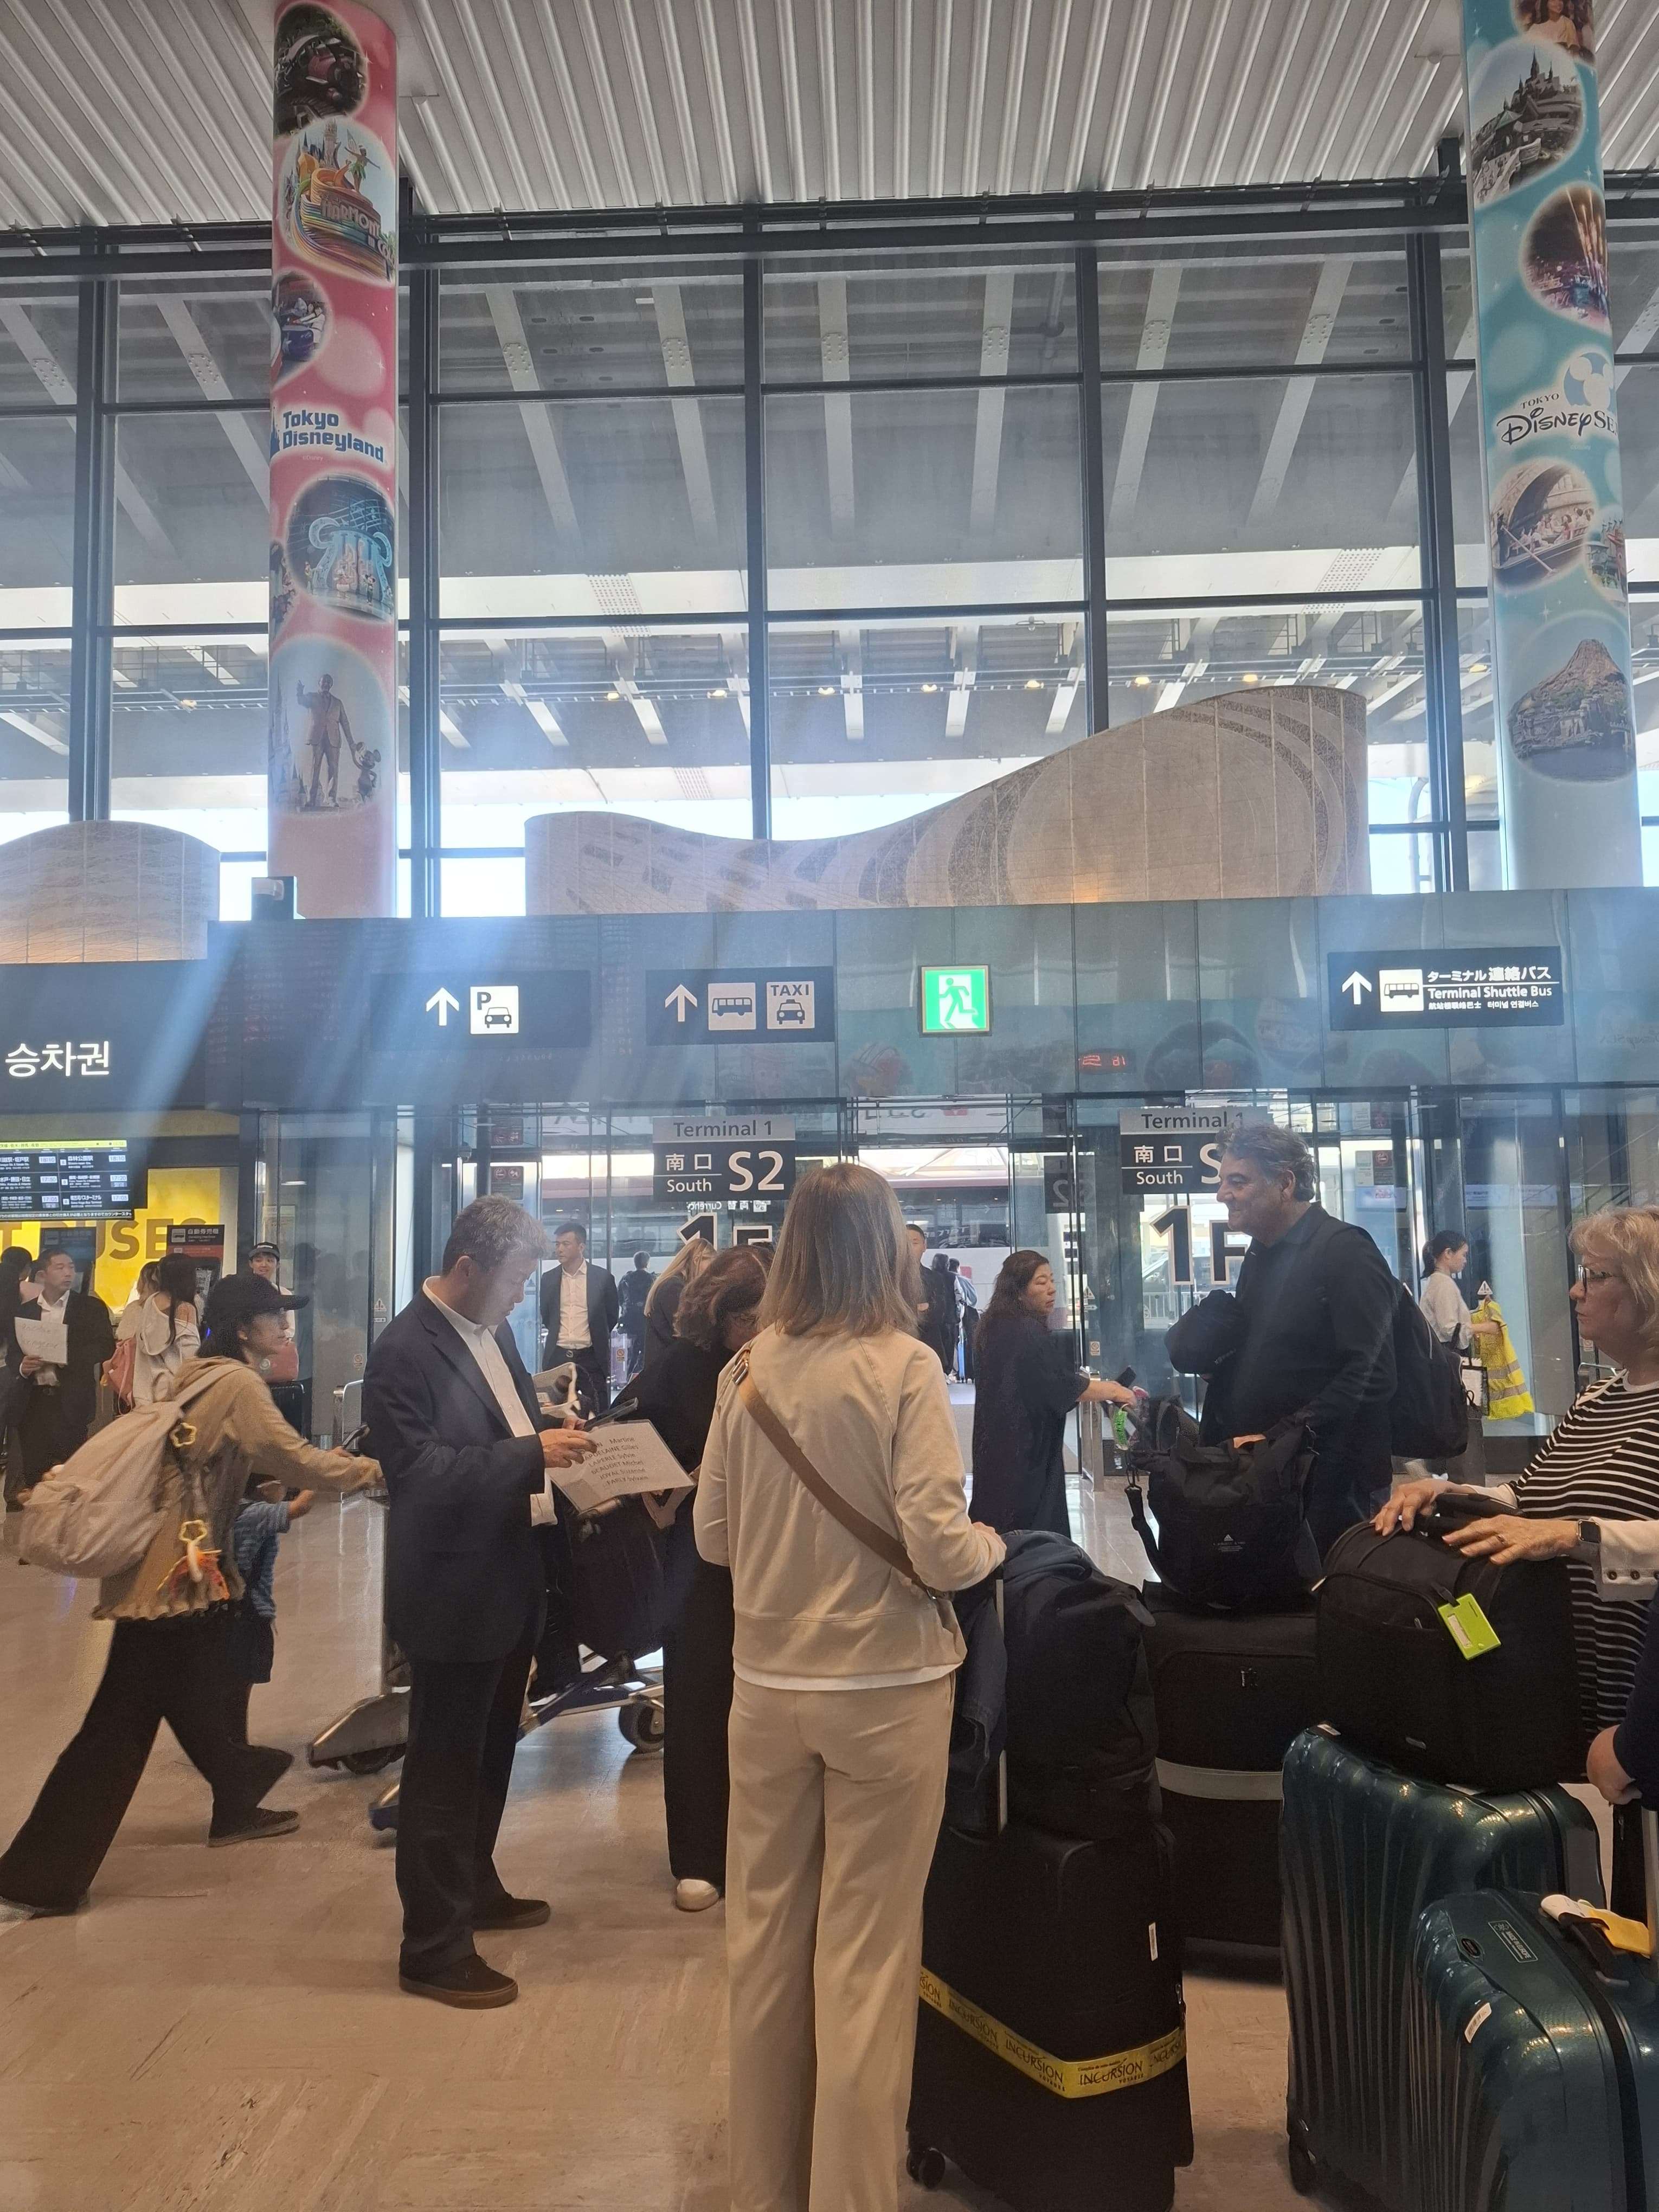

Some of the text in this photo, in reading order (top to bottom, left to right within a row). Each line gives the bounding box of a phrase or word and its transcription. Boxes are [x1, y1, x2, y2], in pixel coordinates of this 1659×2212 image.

[1520, 393, 1559, 409] TOKYO
[283, 409, 339, 429] Tokyo
[283, 430, 384, 463] Disneyland
[770, 984, 809, 996] TAXI
[1427, 986, 1552, 999] Terminal Shuttle Bus
[477, 992, 492, 1010] P
[5, 1040, 110, 1077] 승차권
[673, 1120, 771, 1137] Terminal 1
[1141, 1111, 1227, 1129] Terminal
[665, 1153, 712, 1171] 南口
[1134, 1145, 1183, 1163] 南口
[728, 1150, 785, 1192] S2
[1199, 1143, 1223, 1184] S
[667, 1178, 712, 1193] South
[1136, 1170, 1183, 1185] South
[1149, 1205, 1252, 1285] 1F
[948, 1999, 998, 2043] INCURSION
[1006, 2039, 1063, 2083] INCURSION
[1080, 2060, 1143, 2086] INCURSION
